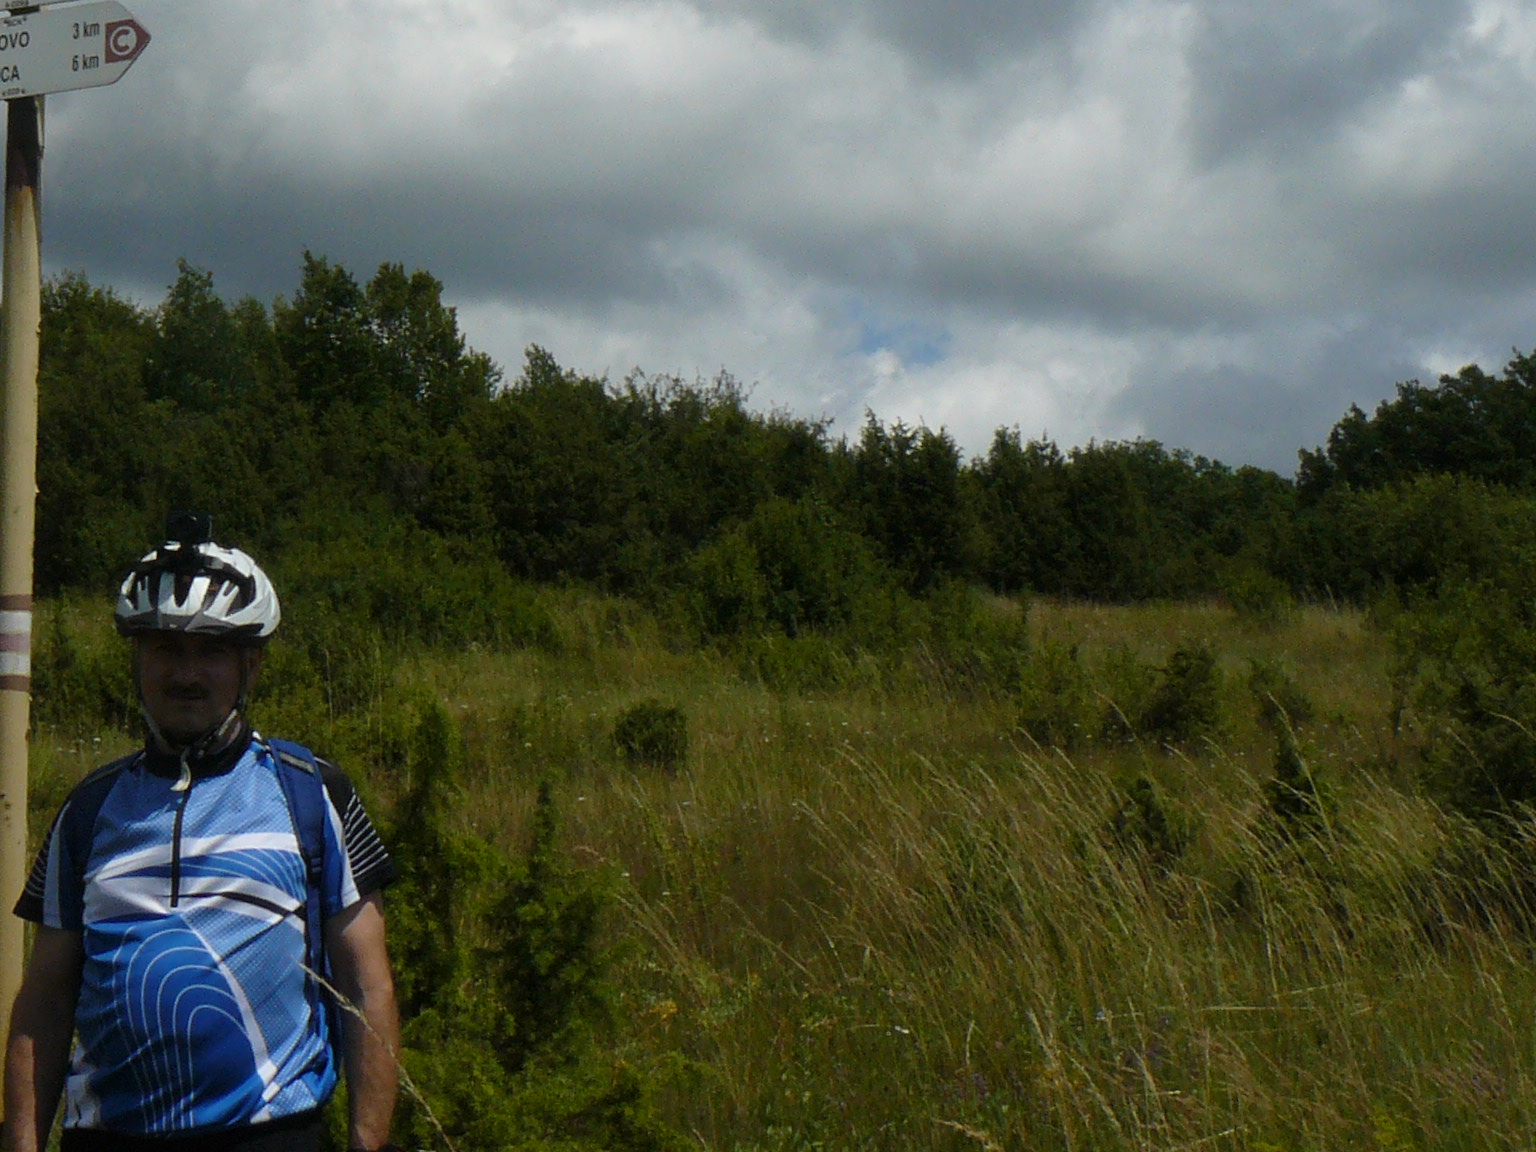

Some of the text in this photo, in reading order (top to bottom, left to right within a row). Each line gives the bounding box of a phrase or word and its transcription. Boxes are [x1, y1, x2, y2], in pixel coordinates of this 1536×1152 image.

[72, 22, 80, 39] 3
[82, 21, 101, 37] km
[72, 54, 80, 72] 6
[82, 53, 100, 70] km
